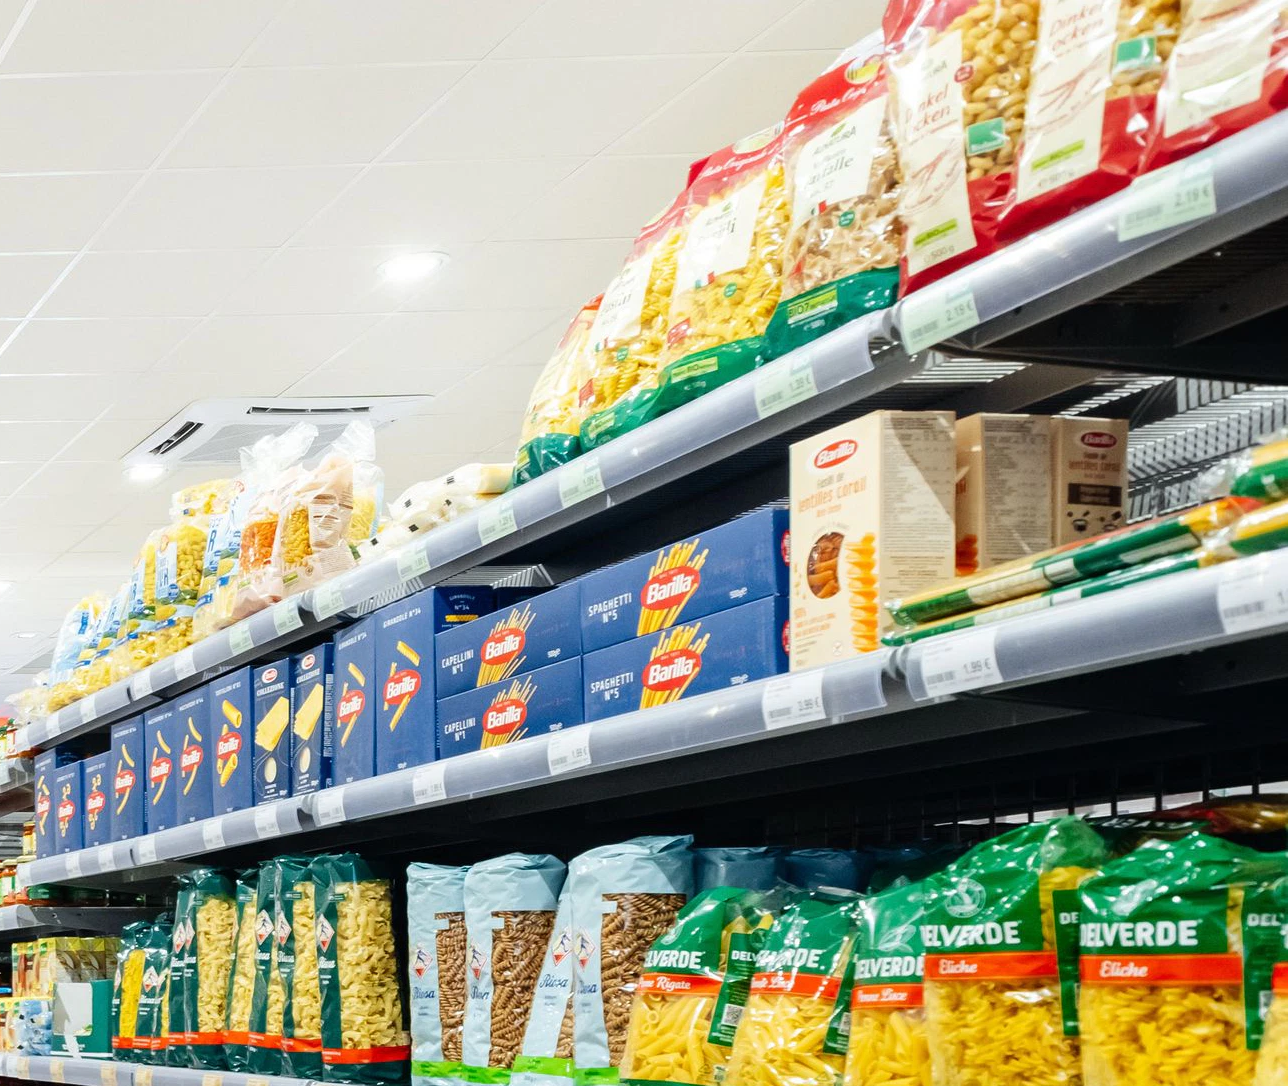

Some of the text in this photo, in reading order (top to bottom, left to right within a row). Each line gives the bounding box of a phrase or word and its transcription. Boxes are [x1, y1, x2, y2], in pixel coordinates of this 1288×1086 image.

[1083, 433, 1115, 445] Barilla
[816, 443, 856, 464] Barilla
[647, 577, 692, 601] Barilla
[588, 592, 632, 617] SPAGHETTI
[602, 609, 618, 623] N°5
[485, 635, 521, 659] Barilla
[441, 649, 474, 669] CAPELLINI
[296, 669, 321, 683] COLLEZIONE
[451, 662, 463, 674] N°1
[647, 661, 694, 685] Barilla
[256, 683, 285, 695] COLLEZIONE
[386, 675, 417, 697] Barilla
[590, 671, 634, 694] SPAGHETTI
[604, 687, 620, 701] N°5
[339, 697, 364, 718] Barilla
[444, 717, 476, 735] CAPELLINI
[487, 707, 522, 731] Barilla
[454, 728, 466, 740] N°1
[217, 737, 240, 756] Barilla
[181, 750, 202, 767] Barilla
[150, 762, 171, 779] Barilla
[115, 775, 134, 790] Barilla
[57, 804, 75, 819] Barilla
[88, 796, 105, 811] Barilla
[939, 958, 978, 975] Eliche
[1099, 961, 1148, 978] Eliche
[539, 973, 569, 989] Riesa
[656, 976, 690, 991] Rigate
